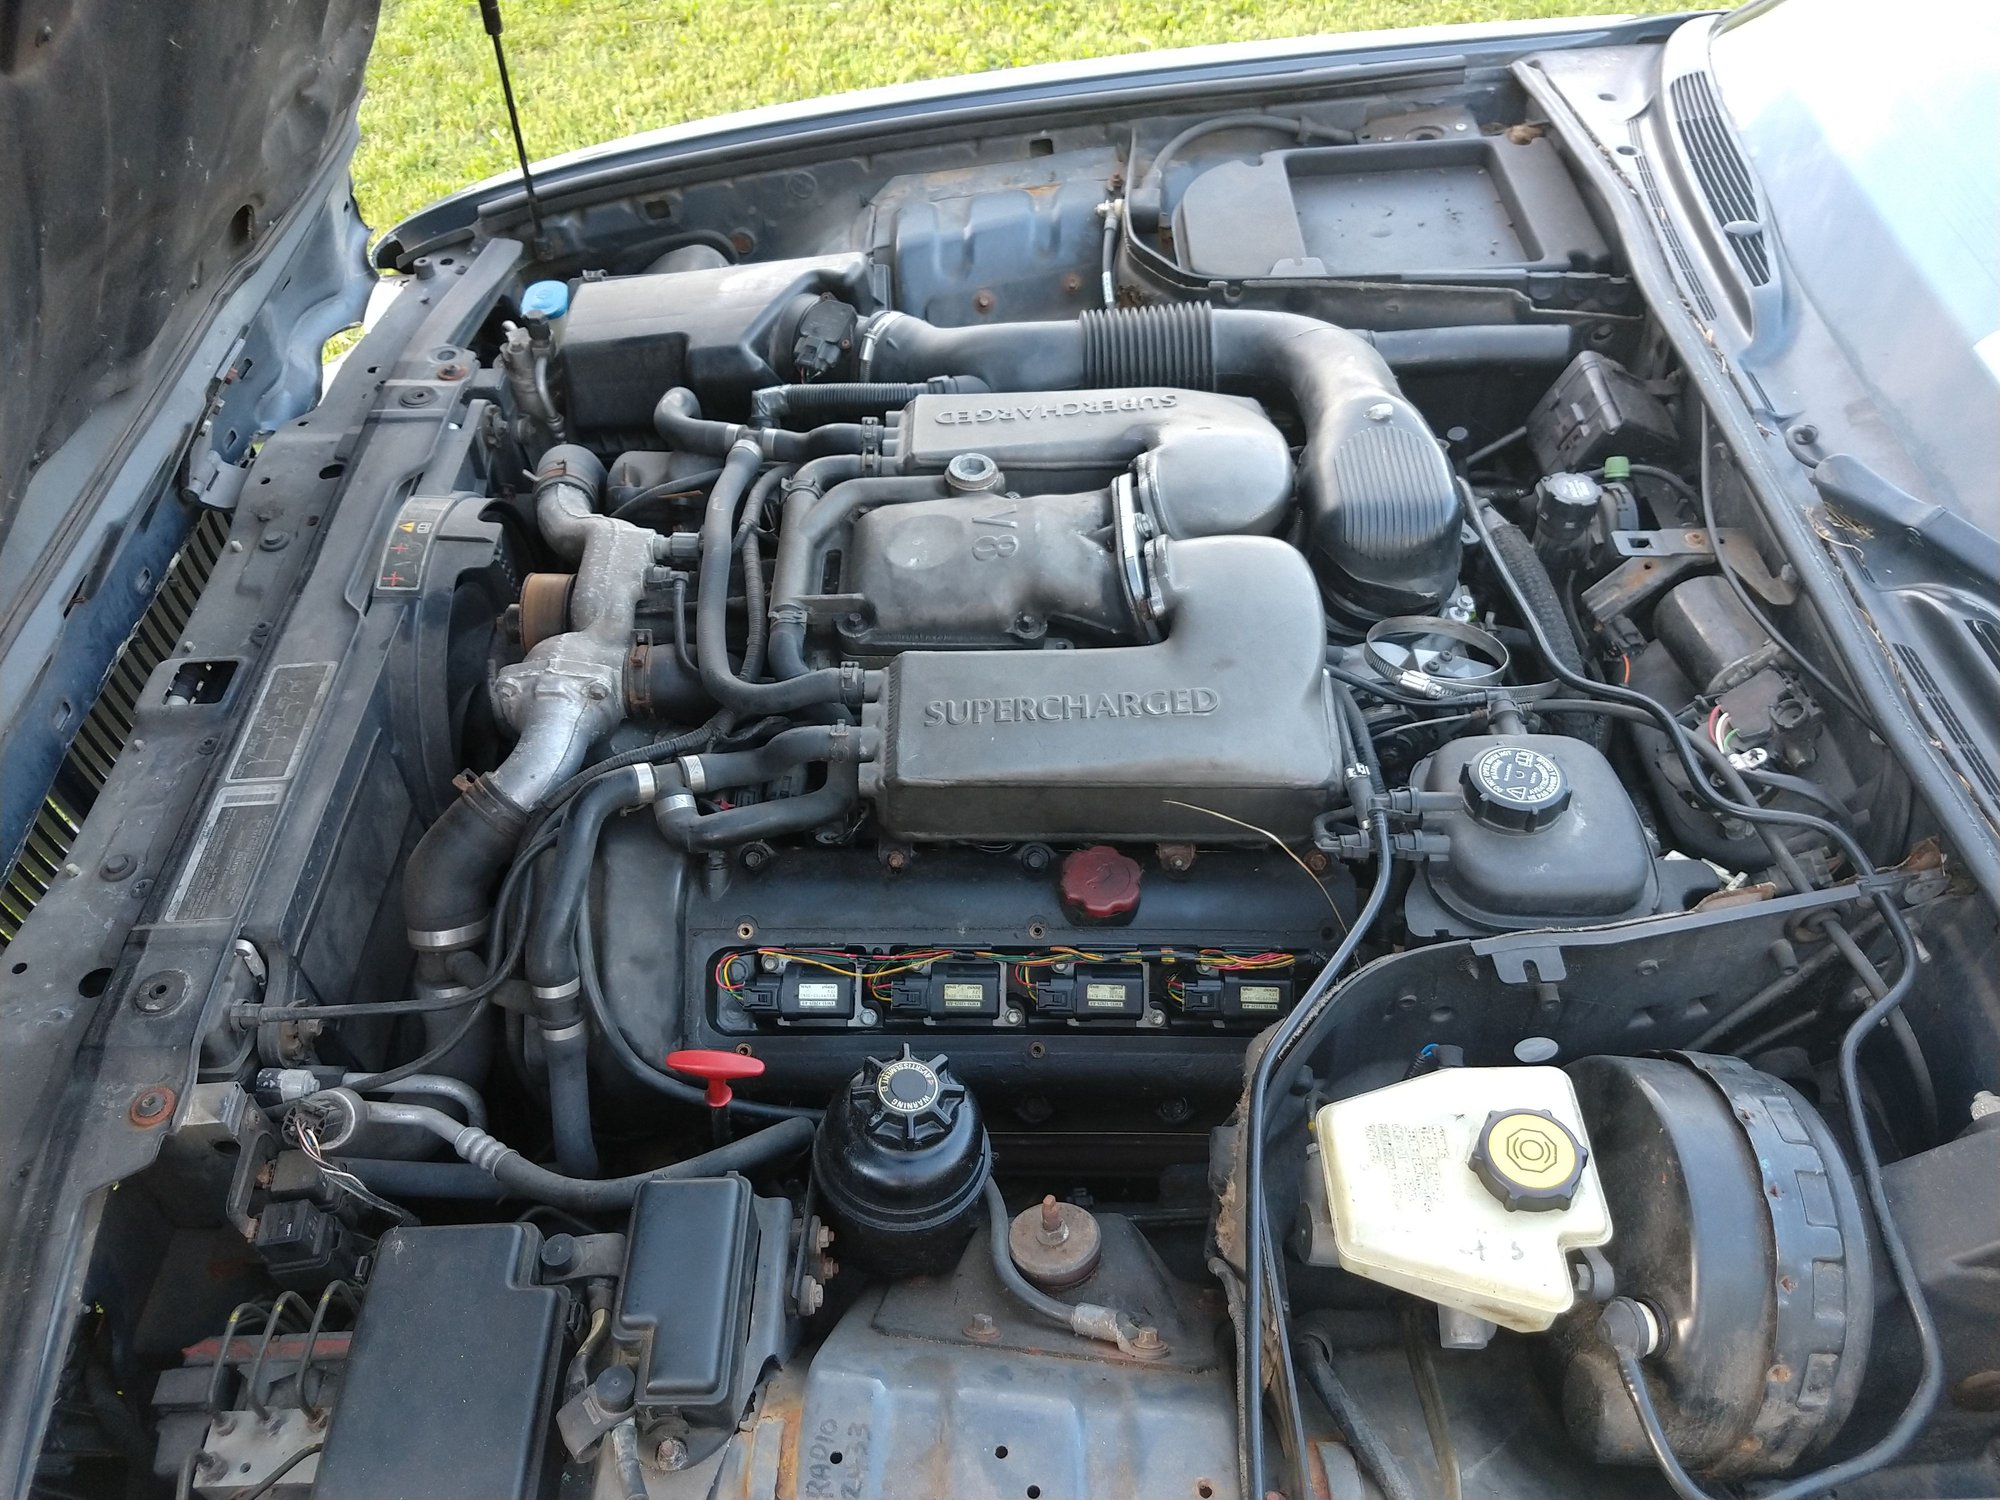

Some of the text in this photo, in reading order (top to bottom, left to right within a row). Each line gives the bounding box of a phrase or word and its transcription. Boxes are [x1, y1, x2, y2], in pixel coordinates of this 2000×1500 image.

[934, 394, 1178, 425] SUPERCHARGED
[971, 504, 1018, 562] V8
[924, 687, 1220, 727] SUPERCHARGED
[881, 1063, 931, 1083] AVERTISSEMENT
[891, 1095, 931, 1109] WARNING
[805, 1418, 837, 1498] RADIO
